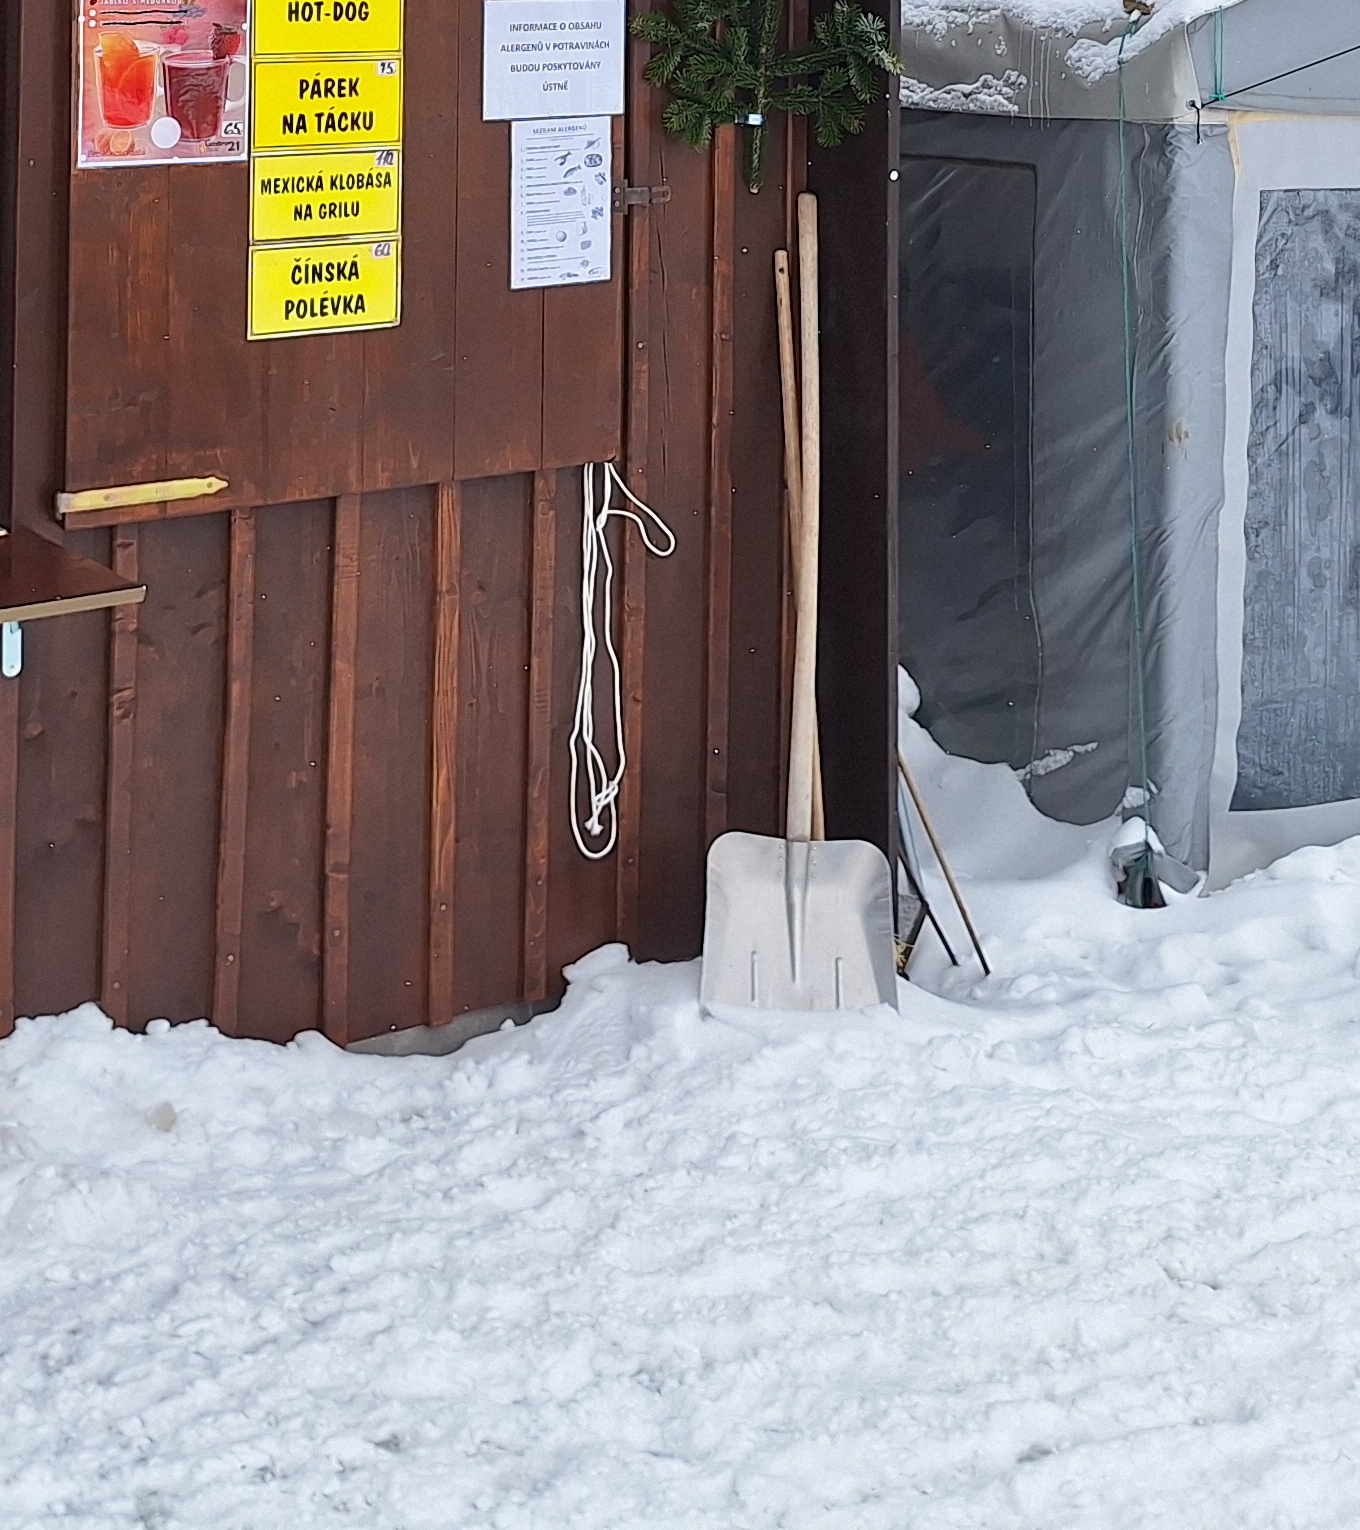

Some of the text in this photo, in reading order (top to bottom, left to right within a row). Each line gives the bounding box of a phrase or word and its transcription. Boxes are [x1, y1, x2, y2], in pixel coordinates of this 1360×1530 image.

[287, 1, 370, 22] HOT-DOG
[509, 21, 602, 32] INFORMACE O OBSAHU
[500, 39, 610, 53] ALERGENŮ V POTRAVINÁCH
[510, 60, 601, 73] BUDOU POSKYTOVÁNY
[299, 72, 360, 100] PÁREK
[542, 80, 569, 92] ÚSTNĚ
[282, 106, 374, 135] NA TÁCKU
[261, 167, 392, 195] MEXICKÁ KLOBÁSA
[293, 201, 360, 221] NA GRILU
[291, 254, 360, 285] ČÍNSKÁ
[285, 291, 366, 320] POLÉVKA
